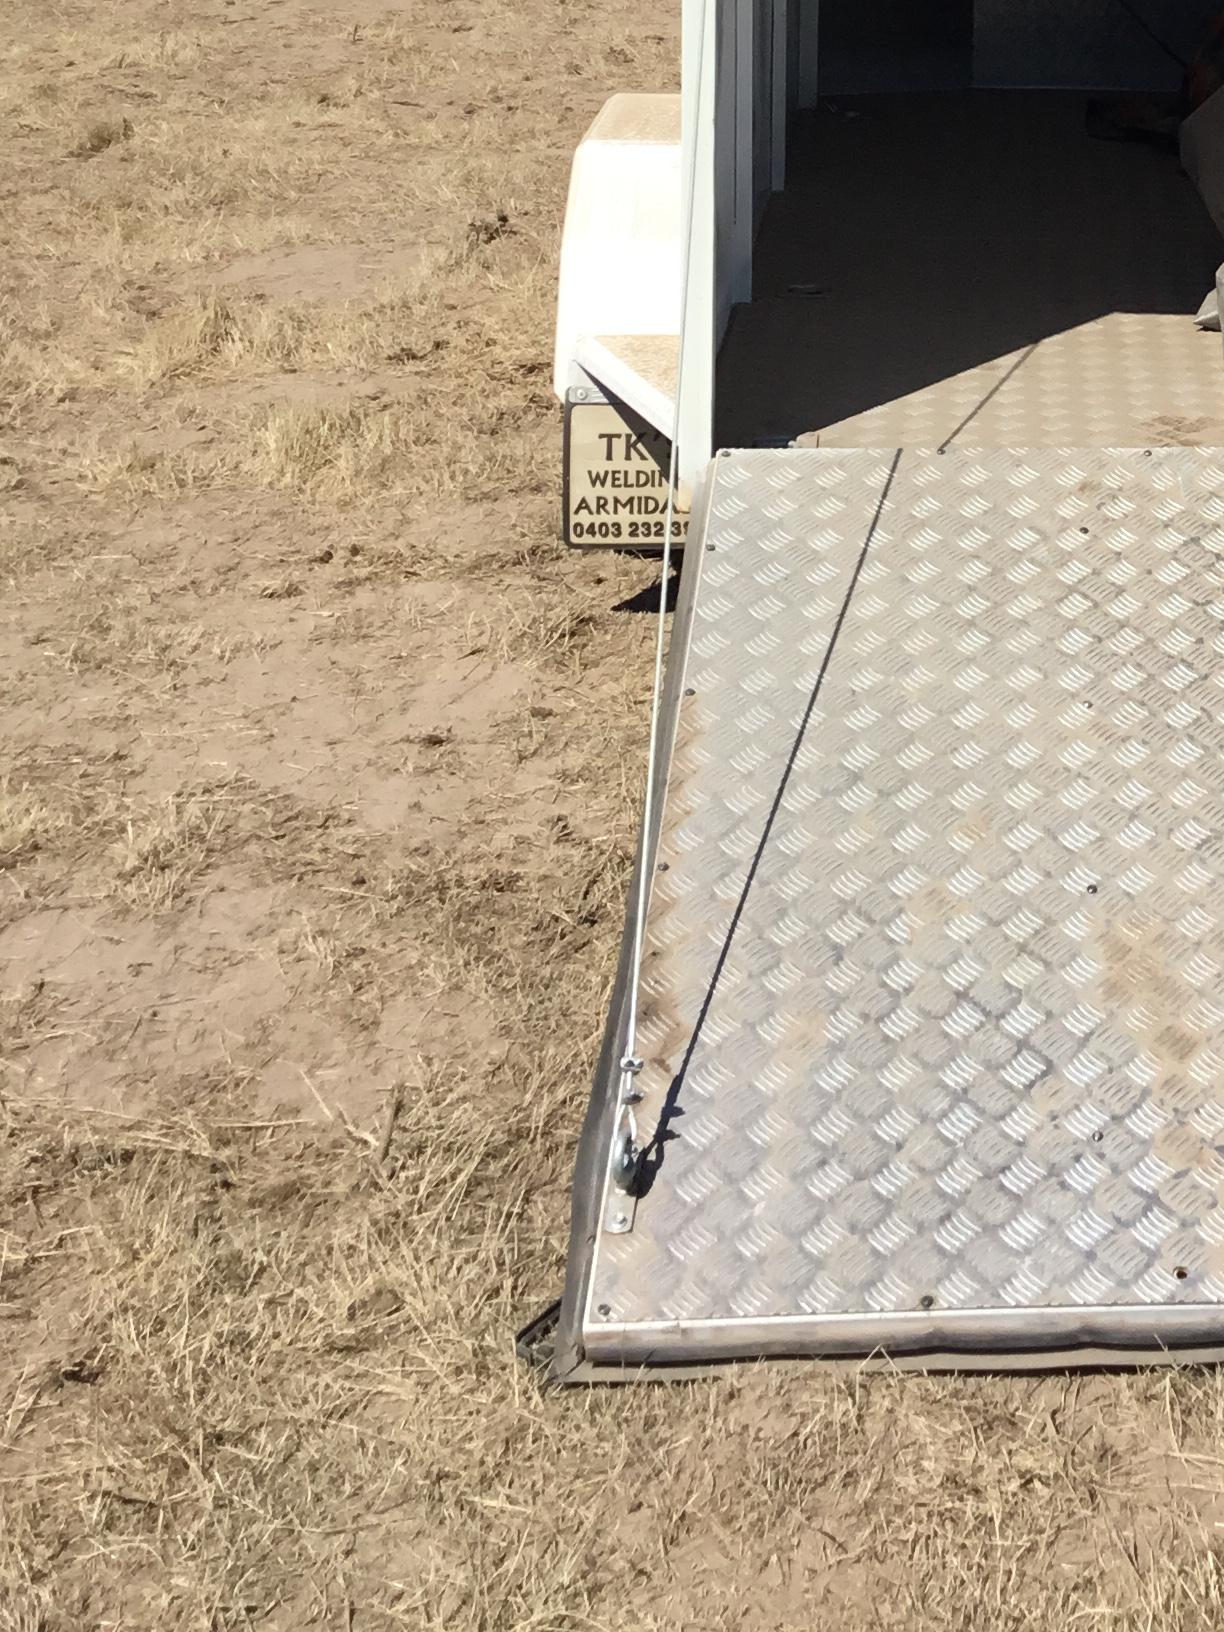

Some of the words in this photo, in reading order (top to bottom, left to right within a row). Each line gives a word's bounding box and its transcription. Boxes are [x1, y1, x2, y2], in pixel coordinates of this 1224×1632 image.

[573, 495, 681, 515] ARMIDA
[572, 521, 623, 538] 0403
[628, 521, 665, 538] 232
